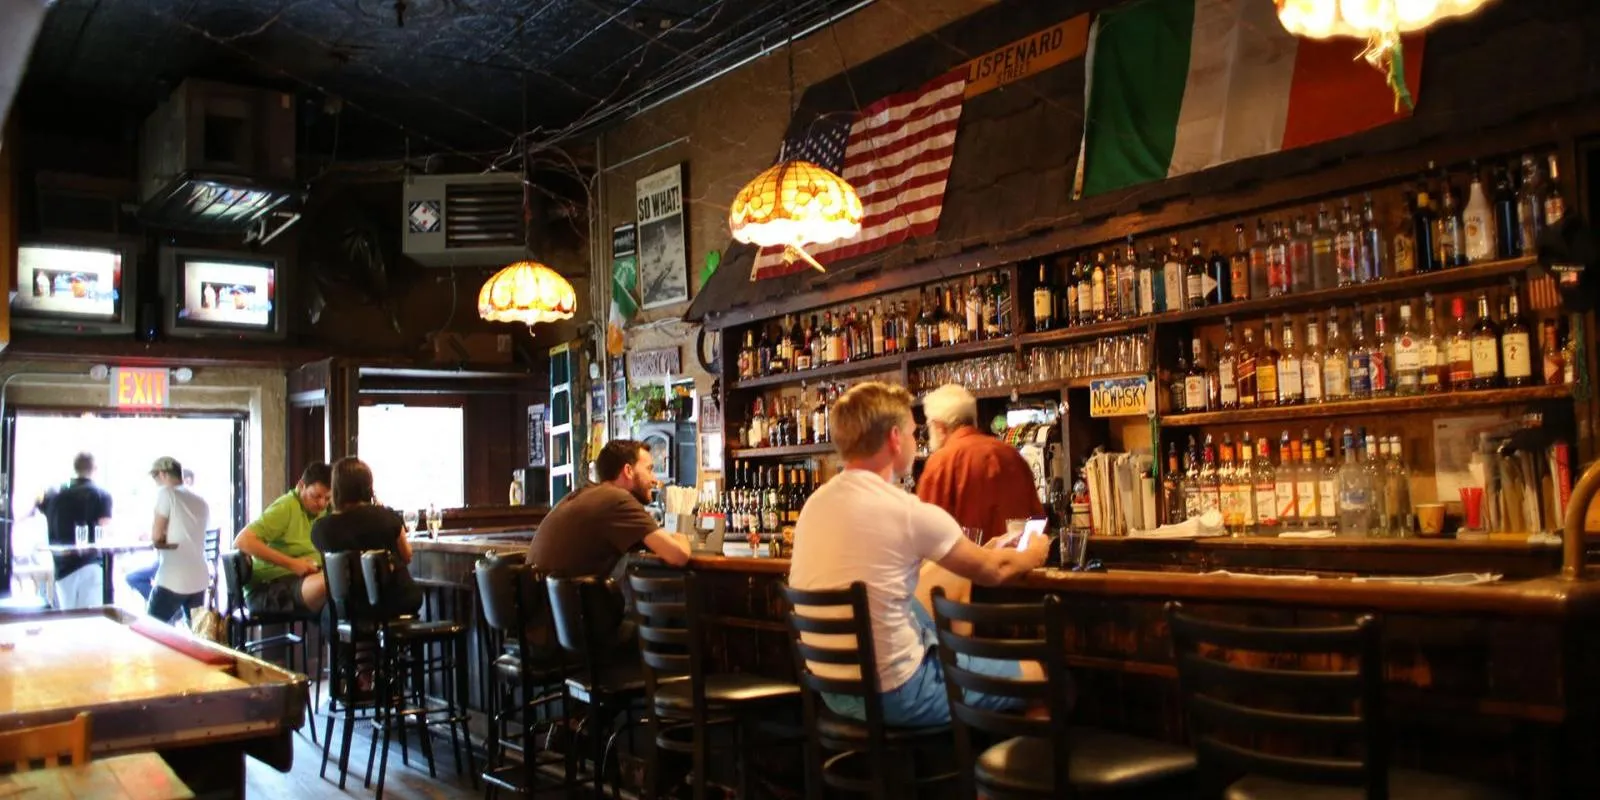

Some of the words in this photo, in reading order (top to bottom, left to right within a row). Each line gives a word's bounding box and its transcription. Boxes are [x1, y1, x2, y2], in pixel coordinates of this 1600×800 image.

[966, 28, 1064, 83] LISPENARD
[997, 61, 1031, 85] STREET
[638, 196, 651, 222] SO
[651, 185, 681, 218] WHAT!
[118, 370, 165, 404] EXIT
[1093, 384, 1147, 409] NCWHSKY
